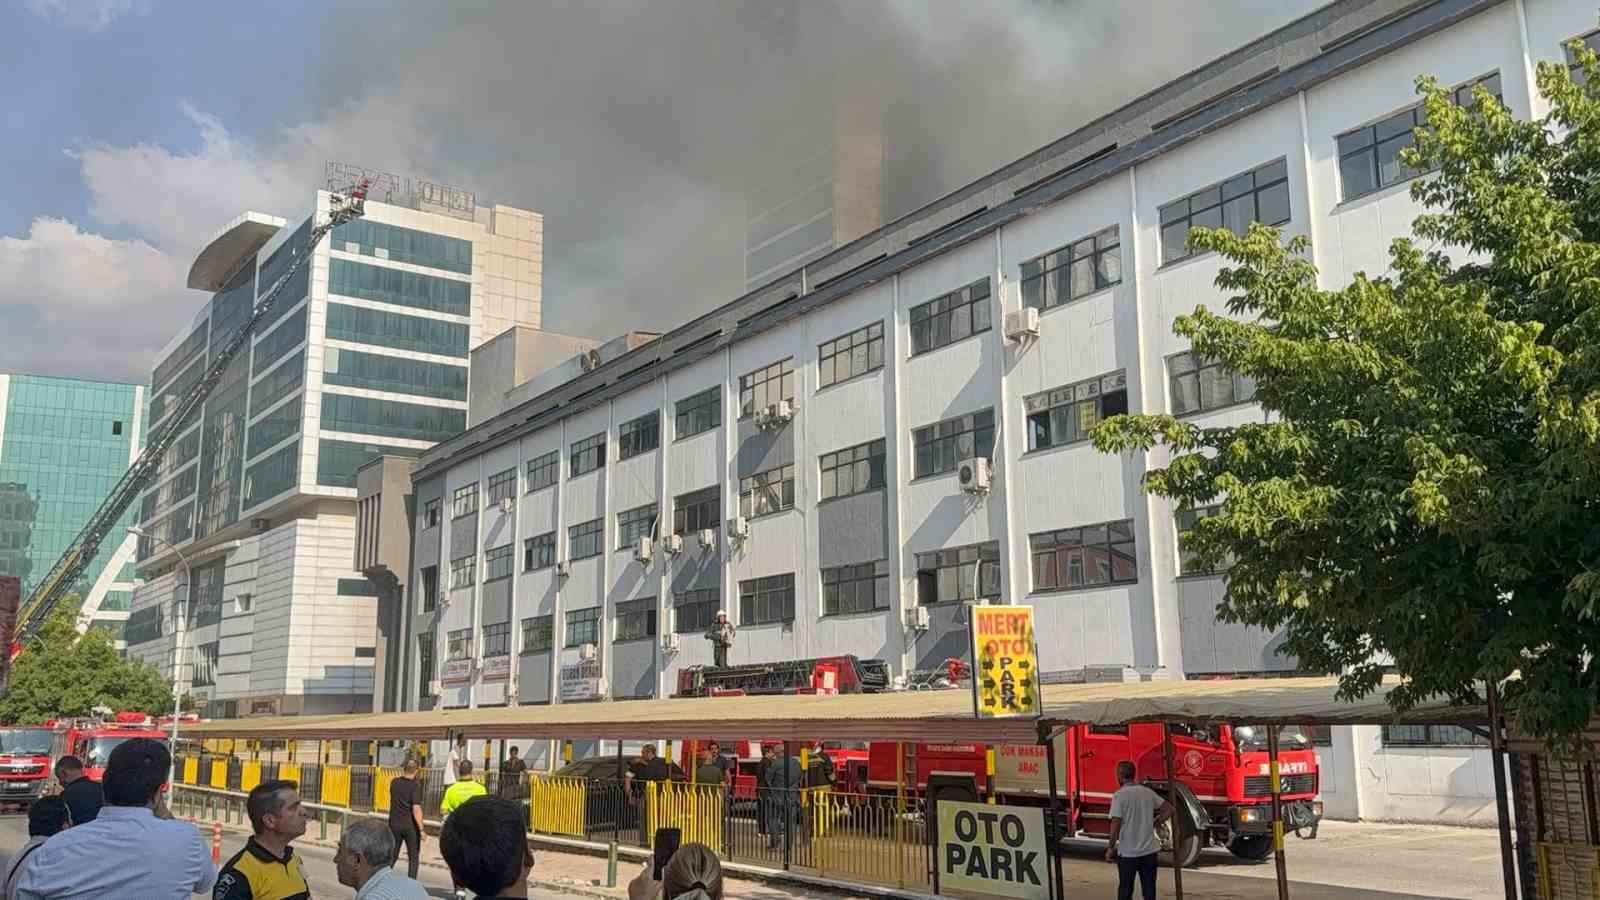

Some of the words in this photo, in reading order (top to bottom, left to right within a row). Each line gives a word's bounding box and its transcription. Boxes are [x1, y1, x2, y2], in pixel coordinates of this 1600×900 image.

[977, 613, 1028, 635] MERT
[986, 640, 1025, 656] OTO
[1000, 657, 1017, 709] PARK
[954, 810, 1025, 848] OTO
[946, 842, 1042, 886] PARK
